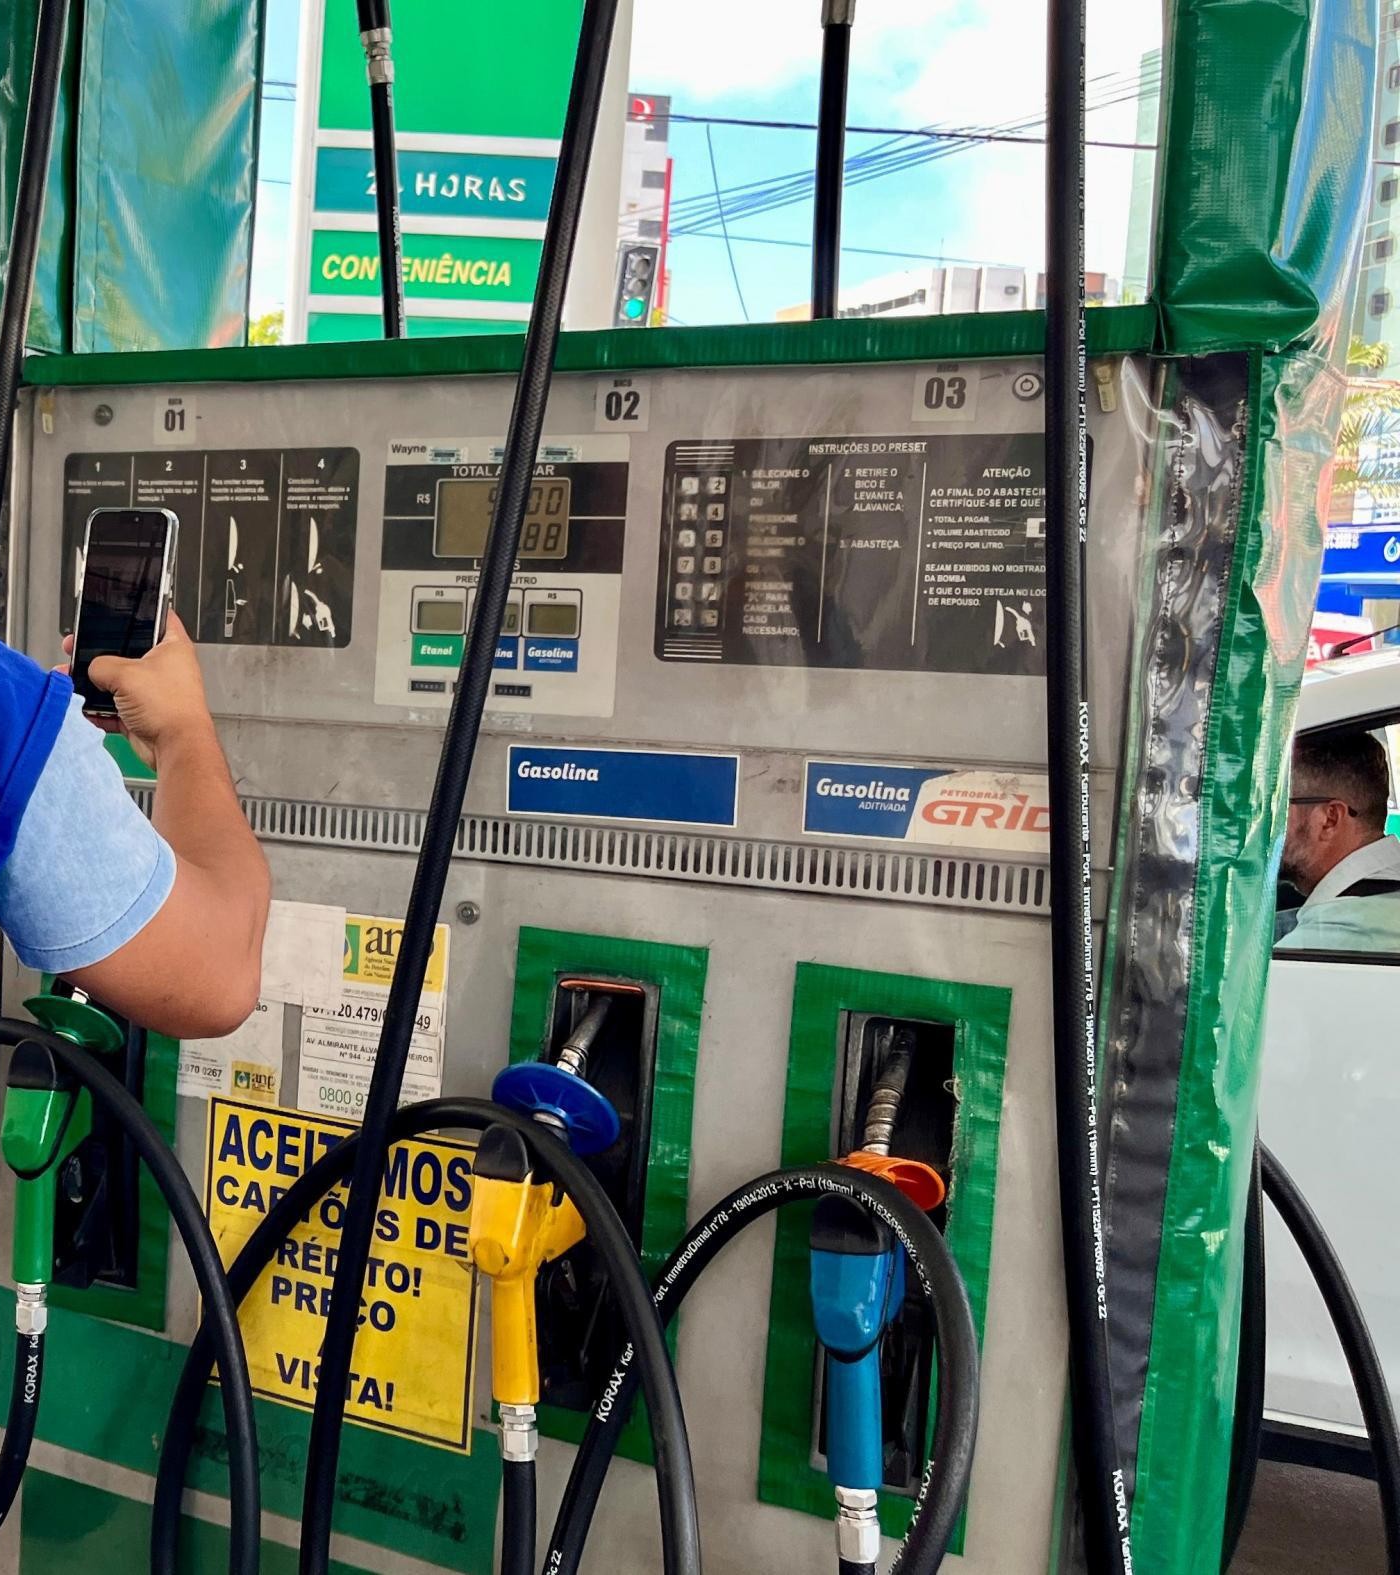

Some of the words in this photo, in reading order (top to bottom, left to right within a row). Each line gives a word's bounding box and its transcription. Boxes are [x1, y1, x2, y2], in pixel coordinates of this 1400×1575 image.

[416, 172, 528, 203] HORAS
[320, 253, 512, 287] CONENIÊNCIA
[924, 376, 967, 410] 03
[605, 391, 640, 421] 02
[164, 408, 186, 432] 01
[391, 444, 427, 455] Wayne
[809, 442, 871, 455] INSTRUÇÕES
[872, 443, 886, 453] DO
[888, 442, 927, 452] PRESET
[95, 461, 101, 472] 1
[165, 460, 173, 472] 2
[240, 459, 247, 471] 3
[317, 458, 326, 469] 4
[451, 465, 492, 477] TOTAL
[856, 468, 888, 477] RETIRE
[890, 468, 898, 477] O
[983, 466, 1031, 480] ATENÇÃO
[855, 480, 877, 488] BICO
[879, 480, 886, 488] E
[416, 493, 430, 504] R$
[854, 491, 894, 500] LEVANTE
[896, 491, 903, 499] A
[947, 488, 975, 497] FINAL
[977, 488, 991, 496] DO
[993, 488, 1046, 497] ABASTECI
[1004, 499, 1018, 507] DE
[1020, 499, 1041, 508] QUE
[933, 529, 963, 537] VOLUME
[964, 529, 1011, 537] ABASTECIDO
[938, 542, 963, 551] PREÇO
[925, 564, 952, 572] SEJAM
[953, 564, 991, 572] EXIBIDOS
[992, 564, 1004, 572] NO
[1006, 565, 1046, 573] MOSTRAD
[925, 575, 936, 583] DA
[937, 575, 966, 583] BOMBA
[935, 588, 953, 596] QUE
[983, 588, 1014, 596] ESTEJA
[1030, 589, 1046, 597] LOC
[928, 598, 939, 606] DE
[420, 645, 453, 656] Etanol
[527, 647, 574, 659] Gasolina
[1079, 701, 1090, 766] KORAX
[517, 760, 599, 783] Gasolina
[815, 777, 911, 803] Gasolina
[940, 788, 1008, 801] PETROBRAS
[858, 801, 907, 813] ADITIVADA
[1081, 773, 1091, 841] Karburante
[318, 1038, 359, 1052] ALMIRANTE
[349, 1052, 361, 1060] 944
[319, 1086, 352, 1105] 0800
[218, 1114, 471, 1213] ACEITMOS
[415, 1217, 469, 1259] DE
[664, 1226, 712, 1284] Inmetro/Dimel
[277, 1236, 422, 1297] RÉDTO!
[1098, 1304, 1108, 1320] 22
[24, 1354, 39, 1403] KORAX
[596, 1368, 626, 1422] KORAX
[1112, 1469, 1129, 1532] KORAX
[551, 1550, 562, 1566] 22
